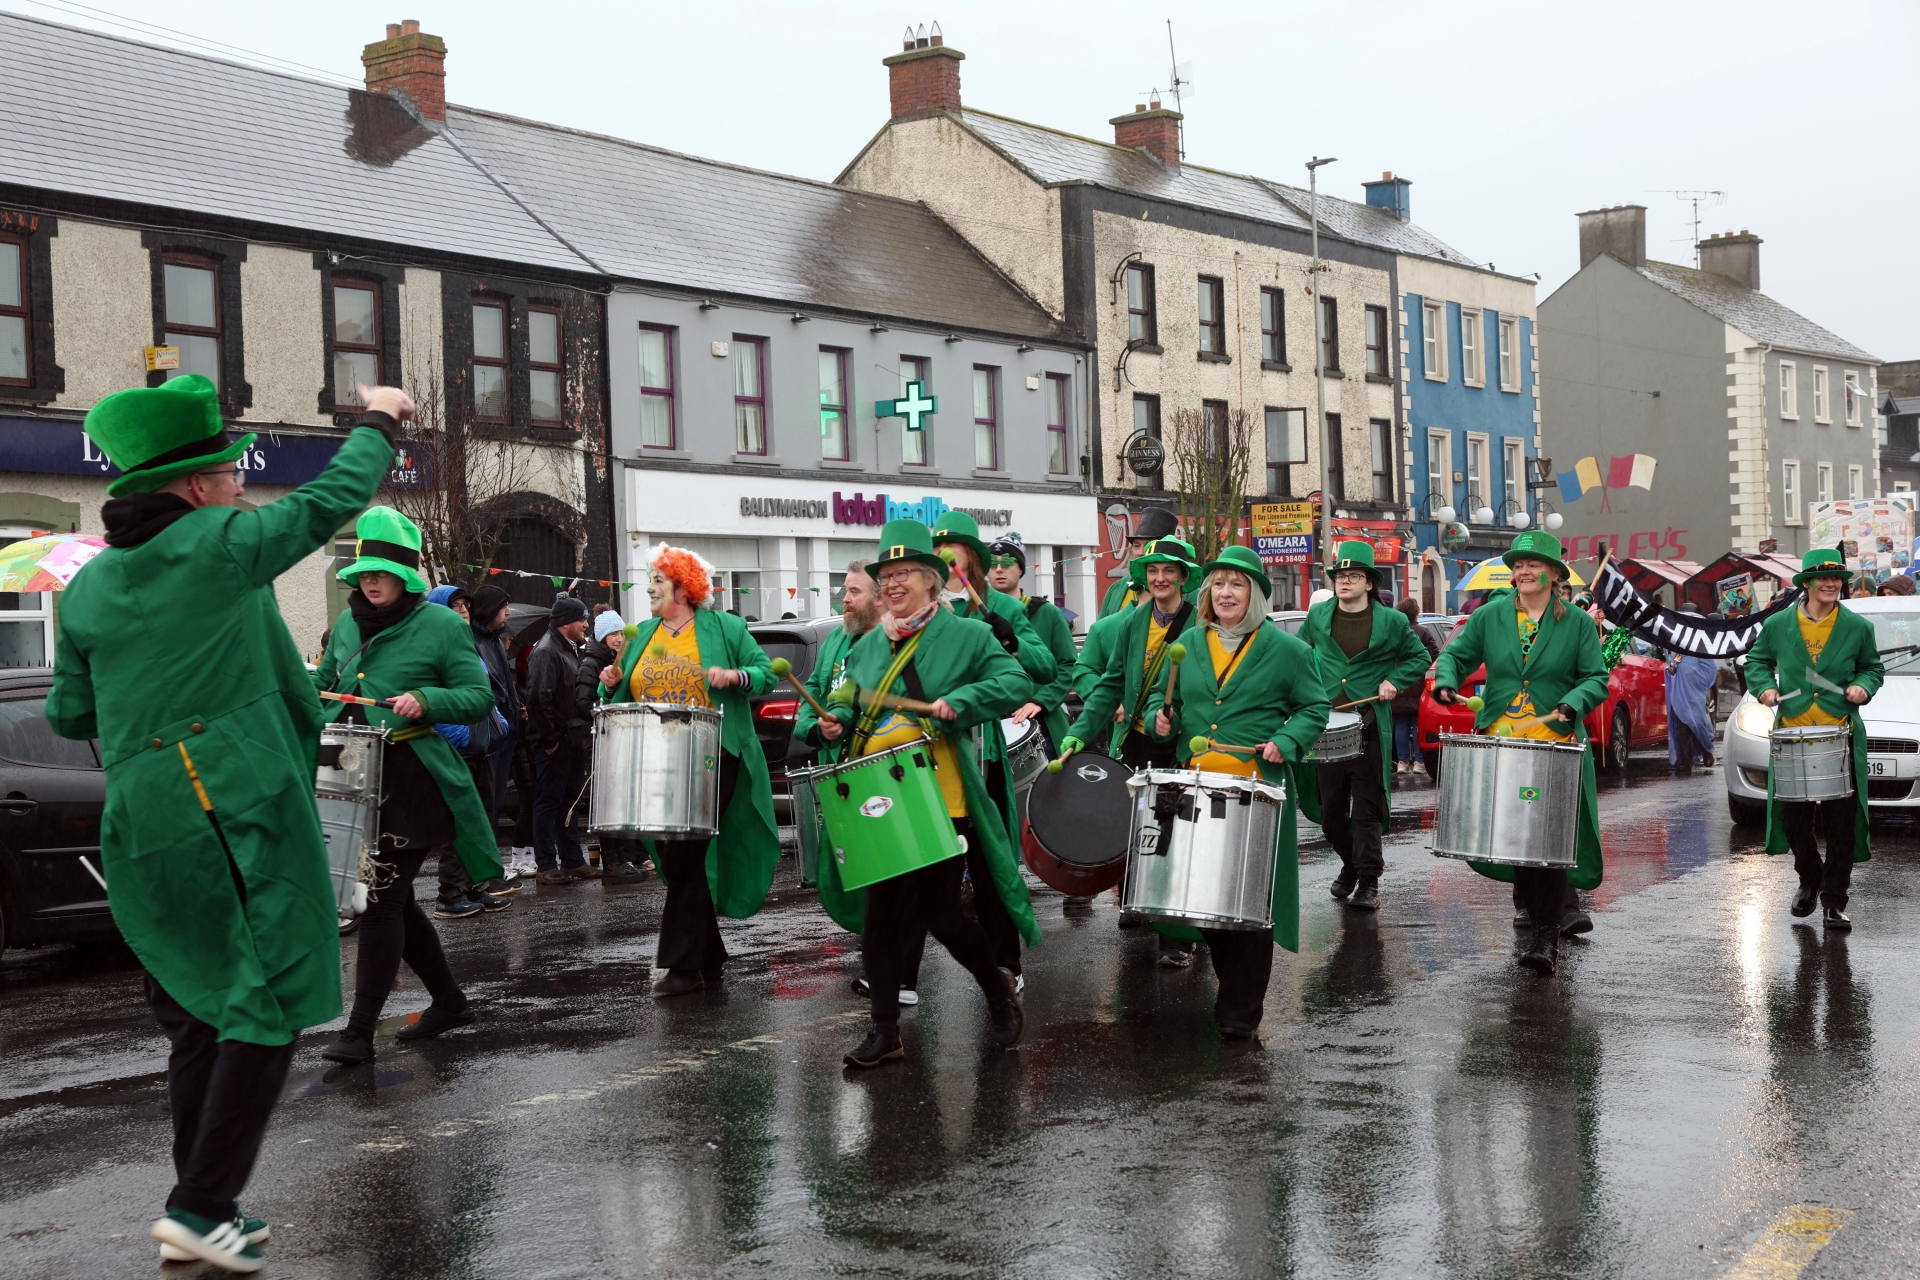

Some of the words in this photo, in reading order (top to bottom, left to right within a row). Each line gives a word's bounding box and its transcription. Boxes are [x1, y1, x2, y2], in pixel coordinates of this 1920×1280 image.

[391, 468, 417, 483] CAFÉ
[740, 496, 828, 518] BALLYMAHON
[952, 507, 1013, 527] ARMACY
[1261, 505, 1279, 513] FOR
[1280, 504, 1302, 512] SALE
[1857, 514, 1909, 547] Story
[1258, 536, 1308, 549] O'MEARA
[1258, 547, 1308, 555] AUCTIONEERING
